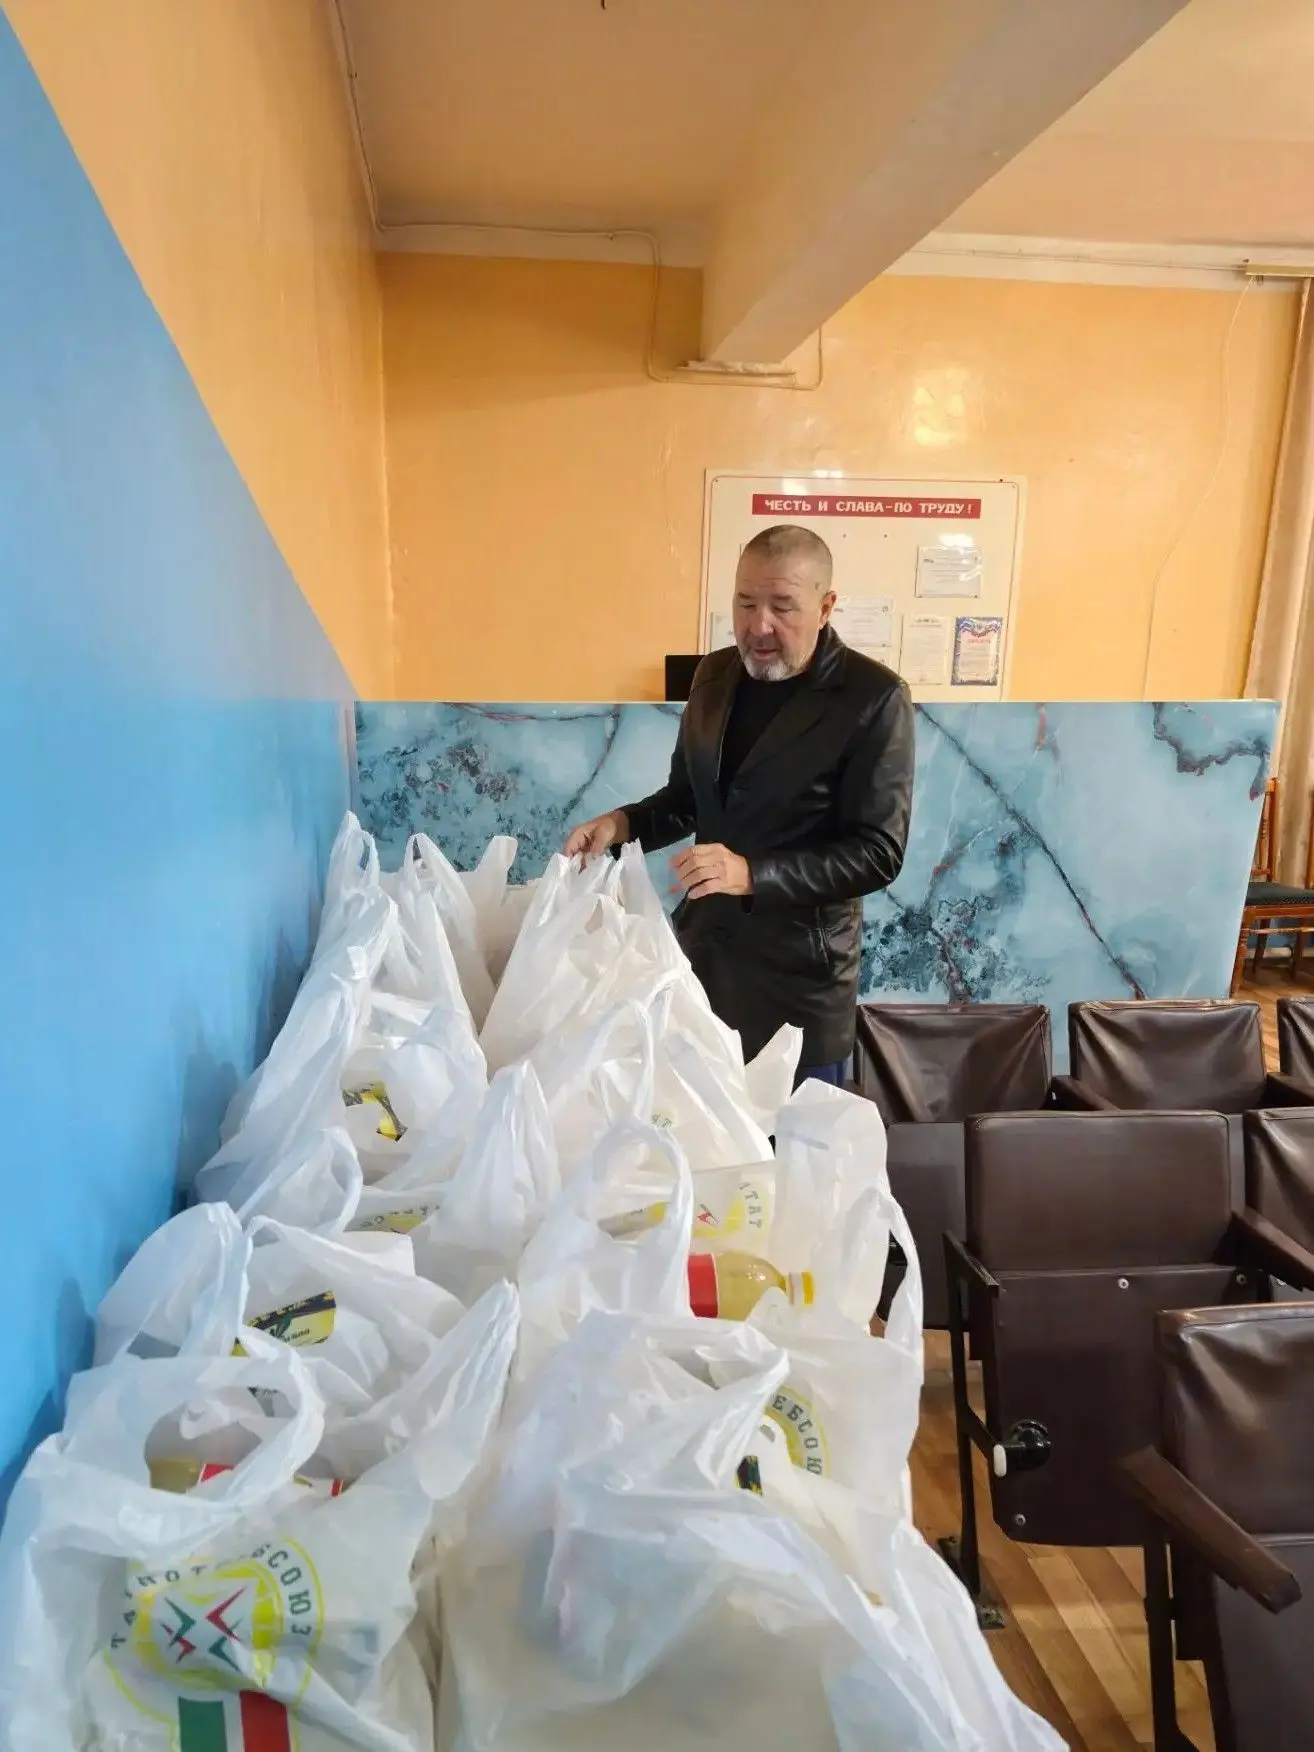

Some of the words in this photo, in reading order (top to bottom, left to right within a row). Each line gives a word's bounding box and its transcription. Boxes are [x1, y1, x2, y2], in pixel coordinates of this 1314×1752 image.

[764, 499, 812, 512] ЧЕСТЬ
[818, 500, 828, 512] И
[919, 502, 972, 515] ТРУДУ!
[769, 1394, 823, 1476] ЕБСОЮ
